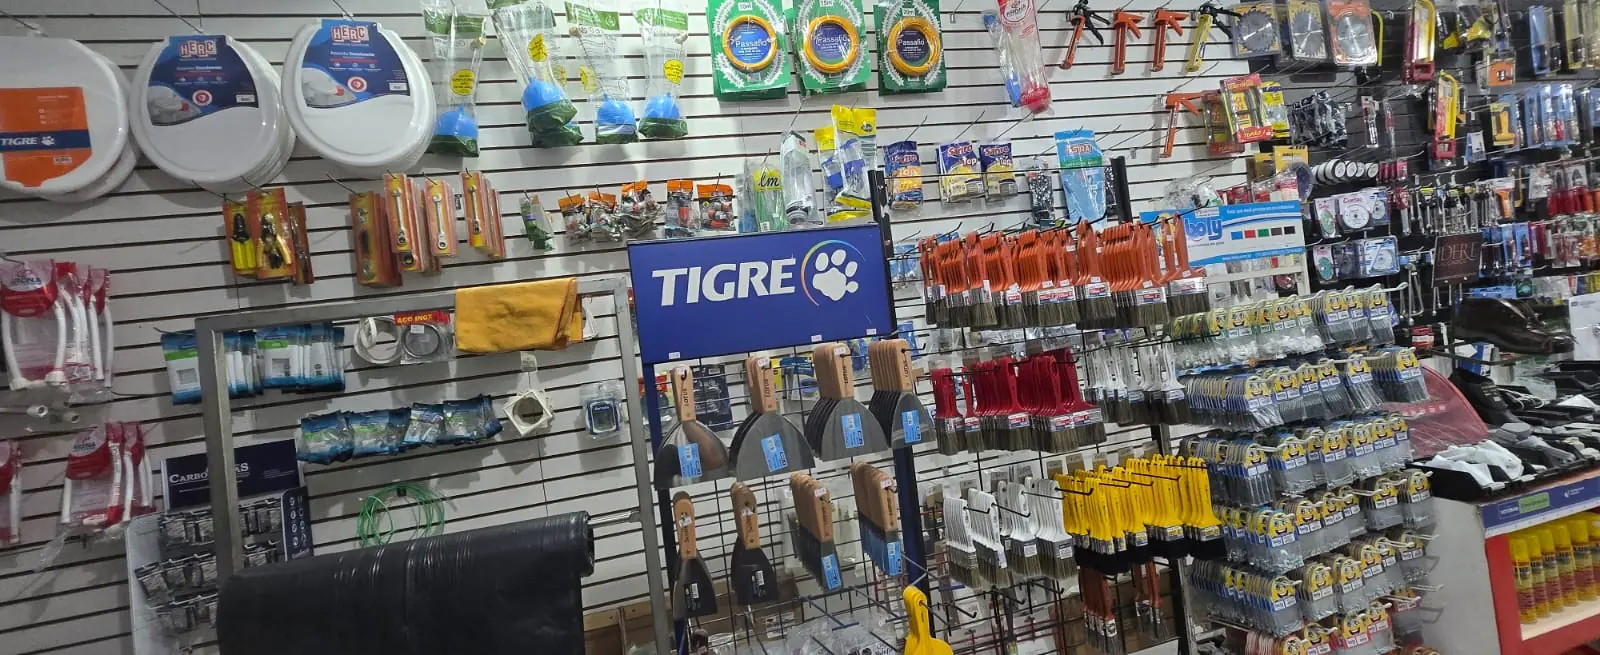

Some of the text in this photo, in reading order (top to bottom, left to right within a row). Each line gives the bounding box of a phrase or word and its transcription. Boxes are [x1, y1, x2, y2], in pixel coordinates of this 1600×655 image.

[332, 26, 367, 41] HERC
[180, 41, 214, 56] HERC
[0, 137, 38, 146] TIGRE
[1183, 218, 1223, 241] boly
[652, 257, 796, 307] TIGRE
